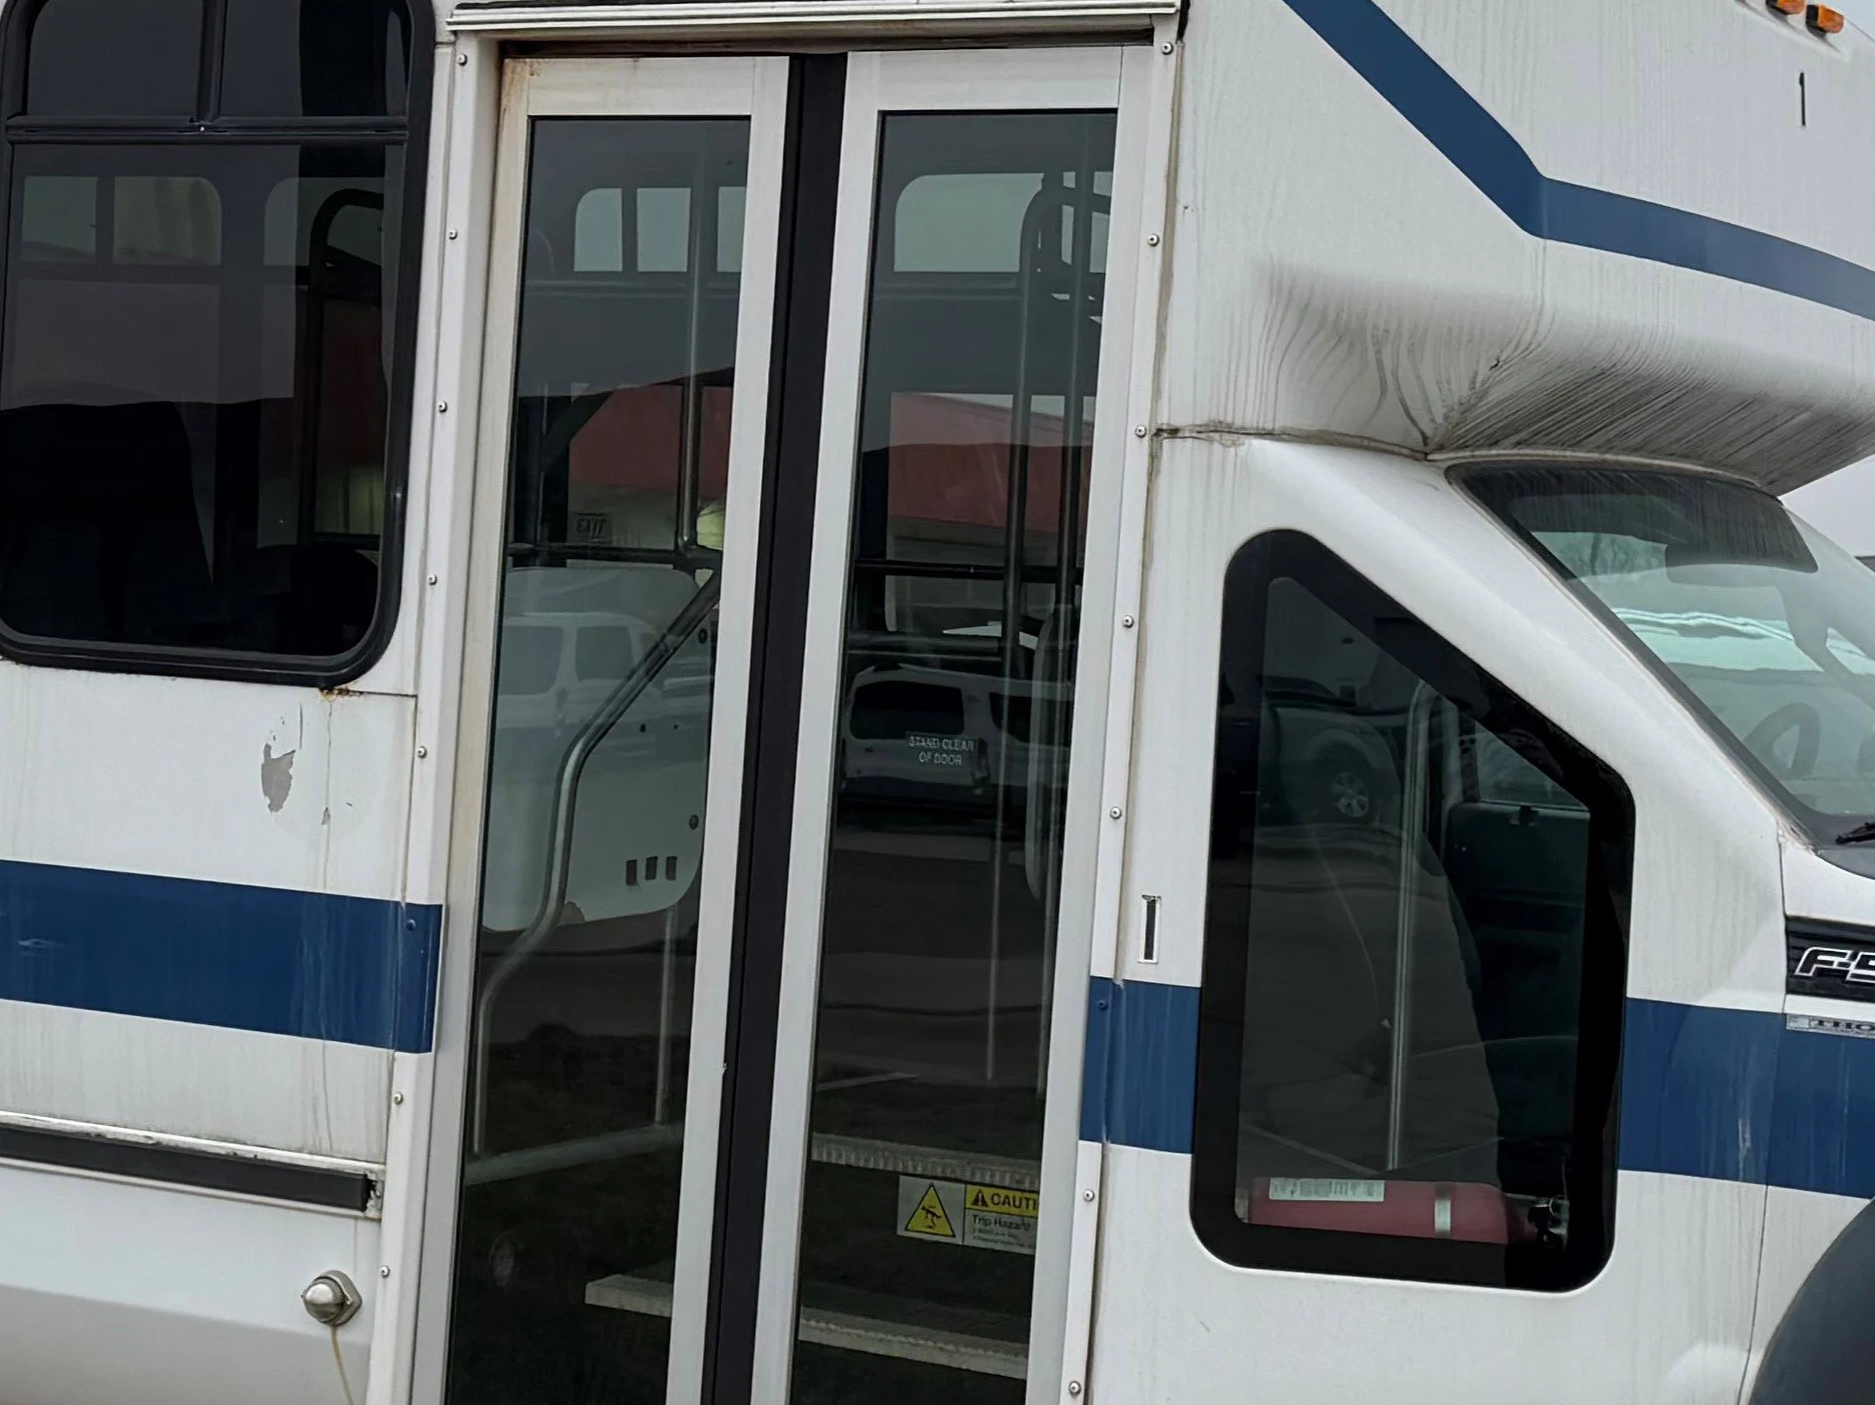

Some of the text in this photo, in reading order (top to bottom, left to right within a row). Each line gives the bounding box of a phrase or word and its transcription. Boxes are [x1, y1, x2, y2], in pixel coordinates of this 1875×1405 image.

[942, 738, 975, 752] CLEAR
[934, 752, 962, 766] DOOR
[990, 1192, 1038, 1211] CAUTI
[972, 1214, 991, 1227] Trip
